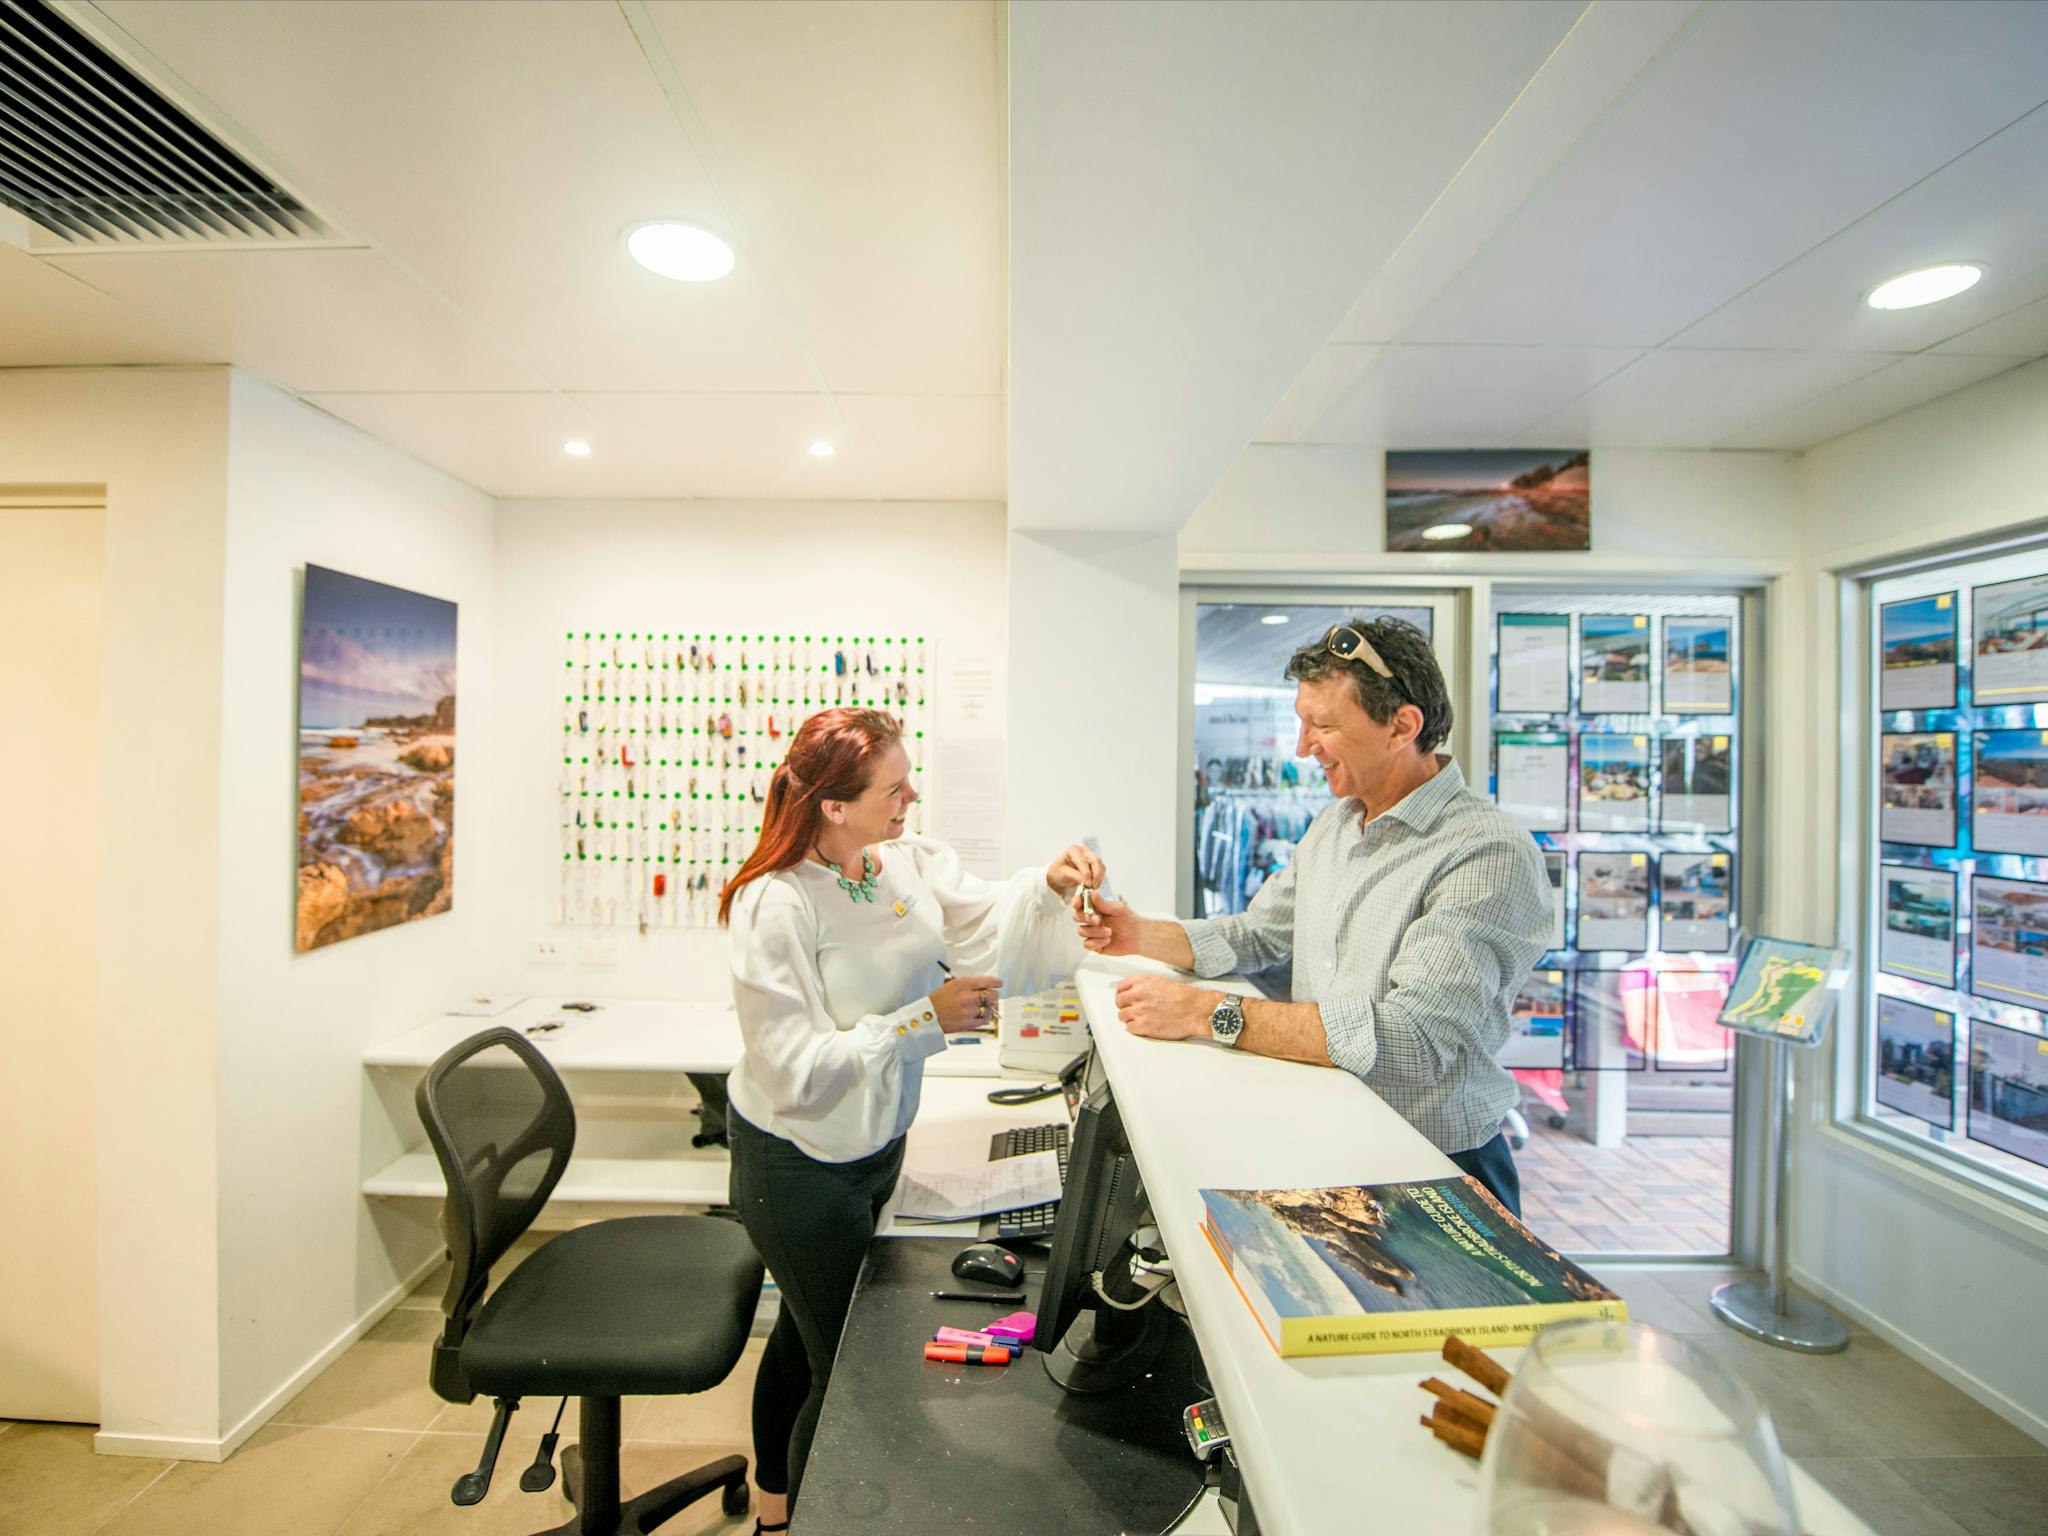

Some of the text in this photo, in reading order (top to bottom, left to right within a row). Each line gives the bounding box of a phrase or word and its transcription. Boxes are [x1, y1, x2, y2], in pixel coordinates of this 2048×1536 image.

[1406, 1188, 1424, 1200] TO
[1415, 1199, 1446, 1223] GUIDE
[1422, 1187, 1545, 1287] NORTH STRADBROKE ISLAND
[1437, 1222, 1479, 1251] NATURE
[1307, 1333, 1314, 1343] A
[1314, 1332, 1350, 1343] NATURE
[1350, 1330, 1377, 1342] GUIDE
[1379, 1329, 1391, 1341] TO
[1391, 1328, 1422, 1340] NORTH
